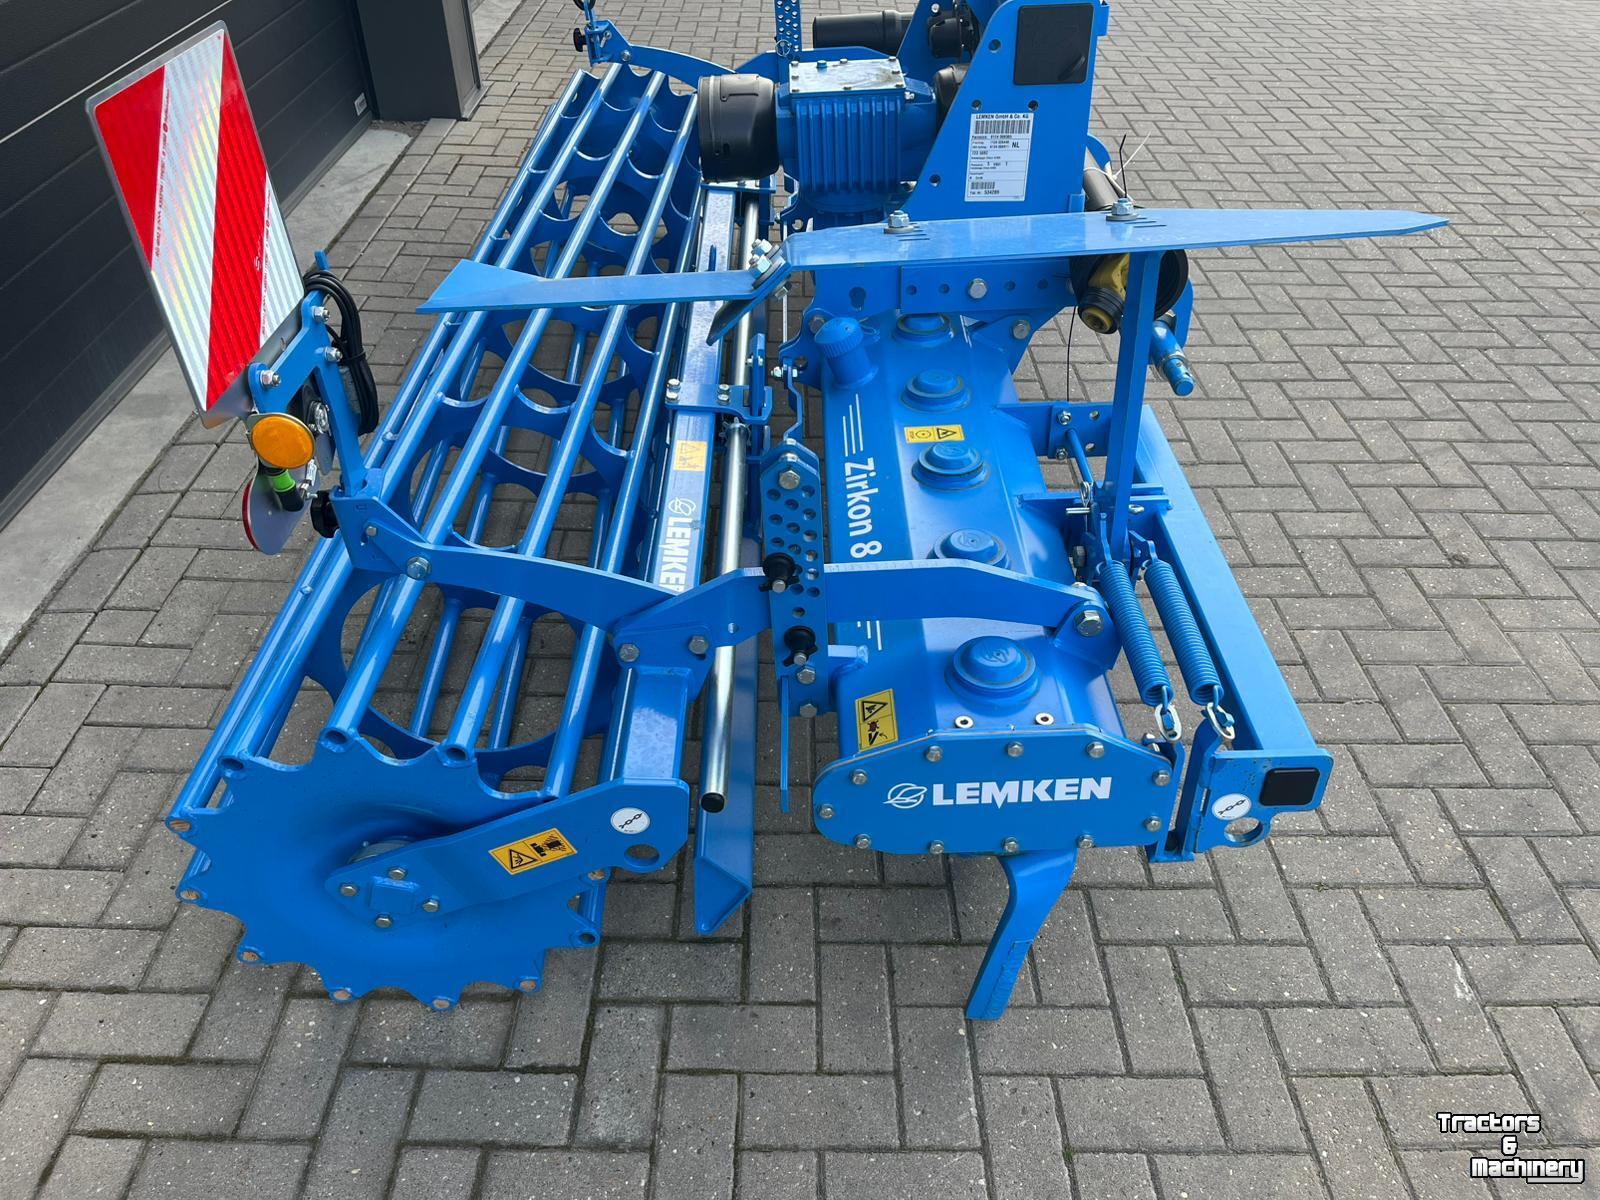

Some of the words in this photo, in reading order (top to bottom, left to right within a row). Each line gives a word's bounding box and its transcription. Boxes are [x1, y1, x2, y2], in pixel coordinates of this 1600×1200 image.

[1012, 141, 1020, 149] NL
[844, 457, 879, 537] Zirkon
[849, 540, 883, 559] 8
[932, 776, 1113, 809] LEMKEN
